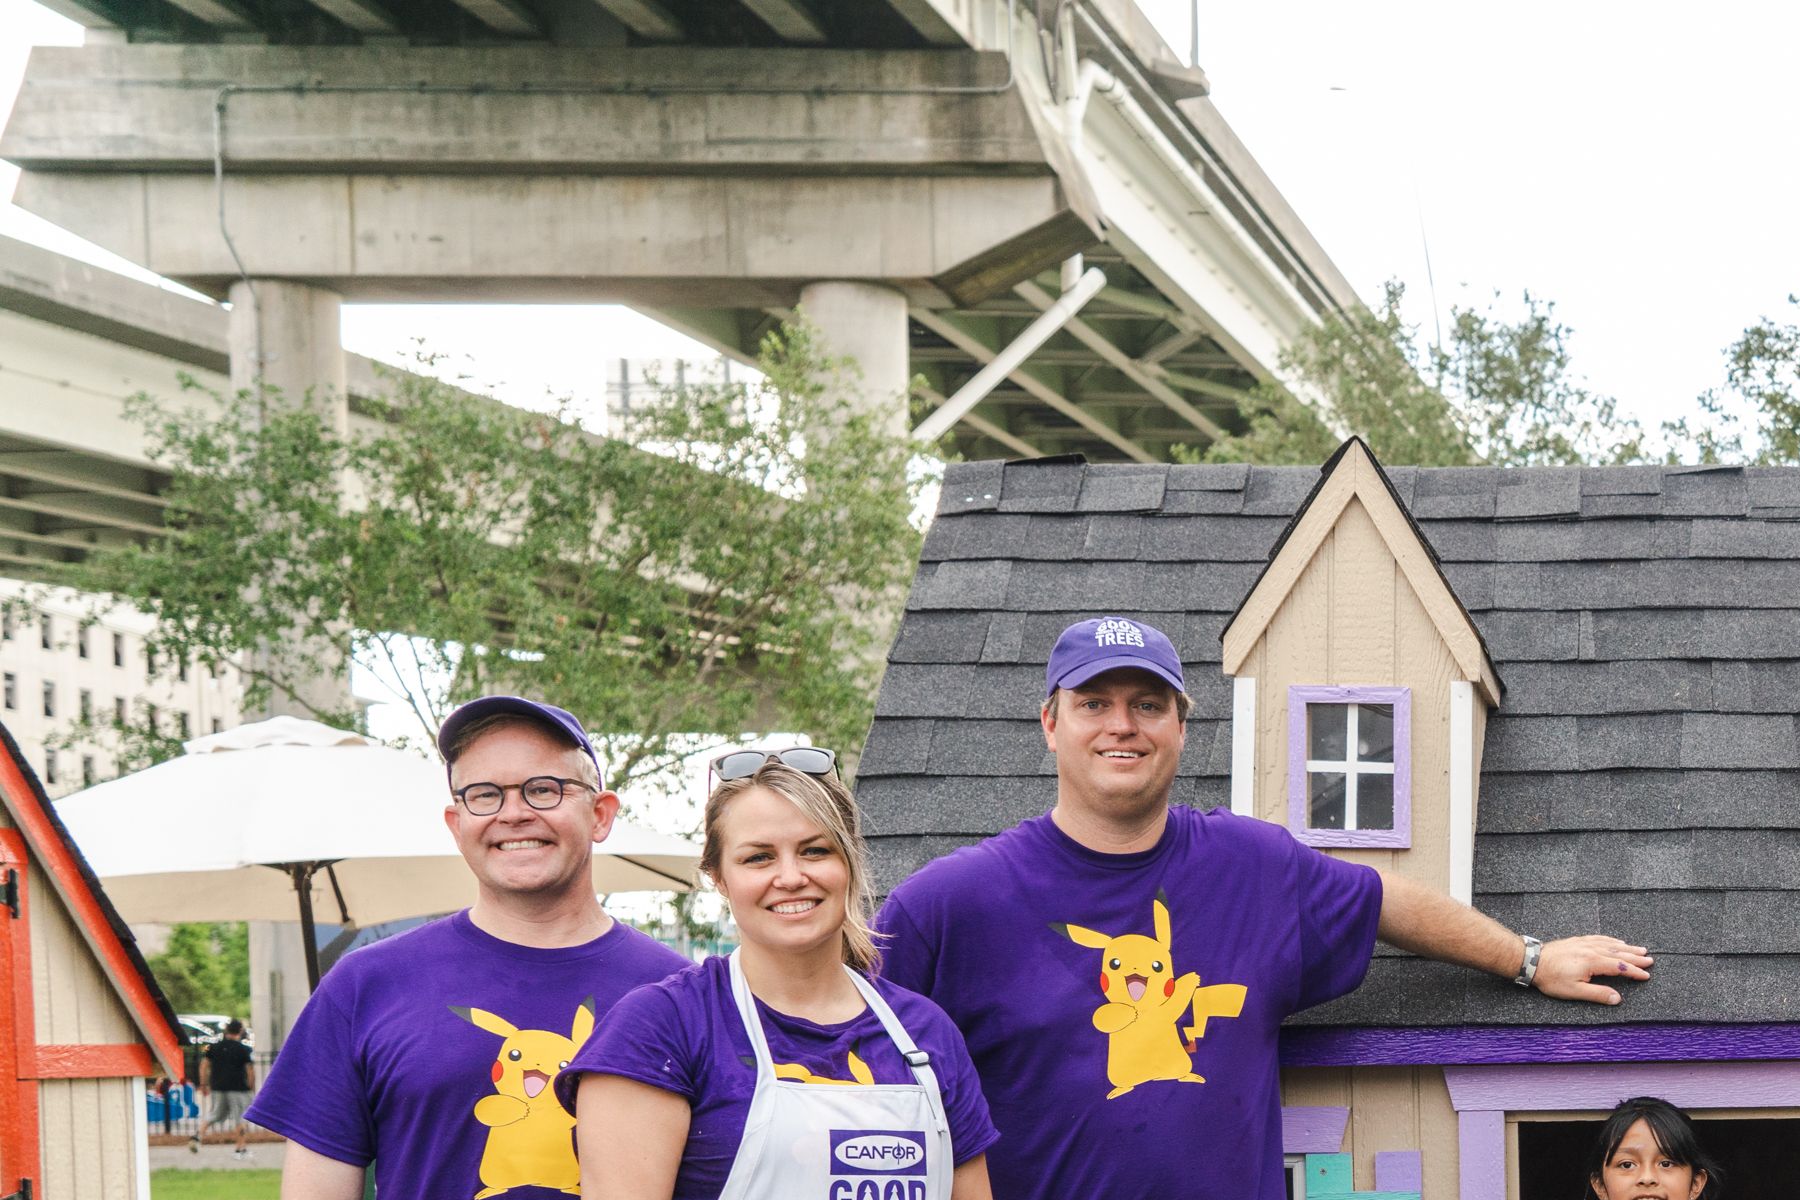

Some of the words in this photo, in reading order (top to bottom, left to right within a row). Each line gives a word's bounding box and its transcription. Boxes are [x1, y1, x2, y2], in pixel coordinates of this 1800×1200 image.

[1097, 620, 1141, 633] GOOD
[1095, 632, 1145, 647] TREES
[845, 1143, 916, 1162] CANFOR
